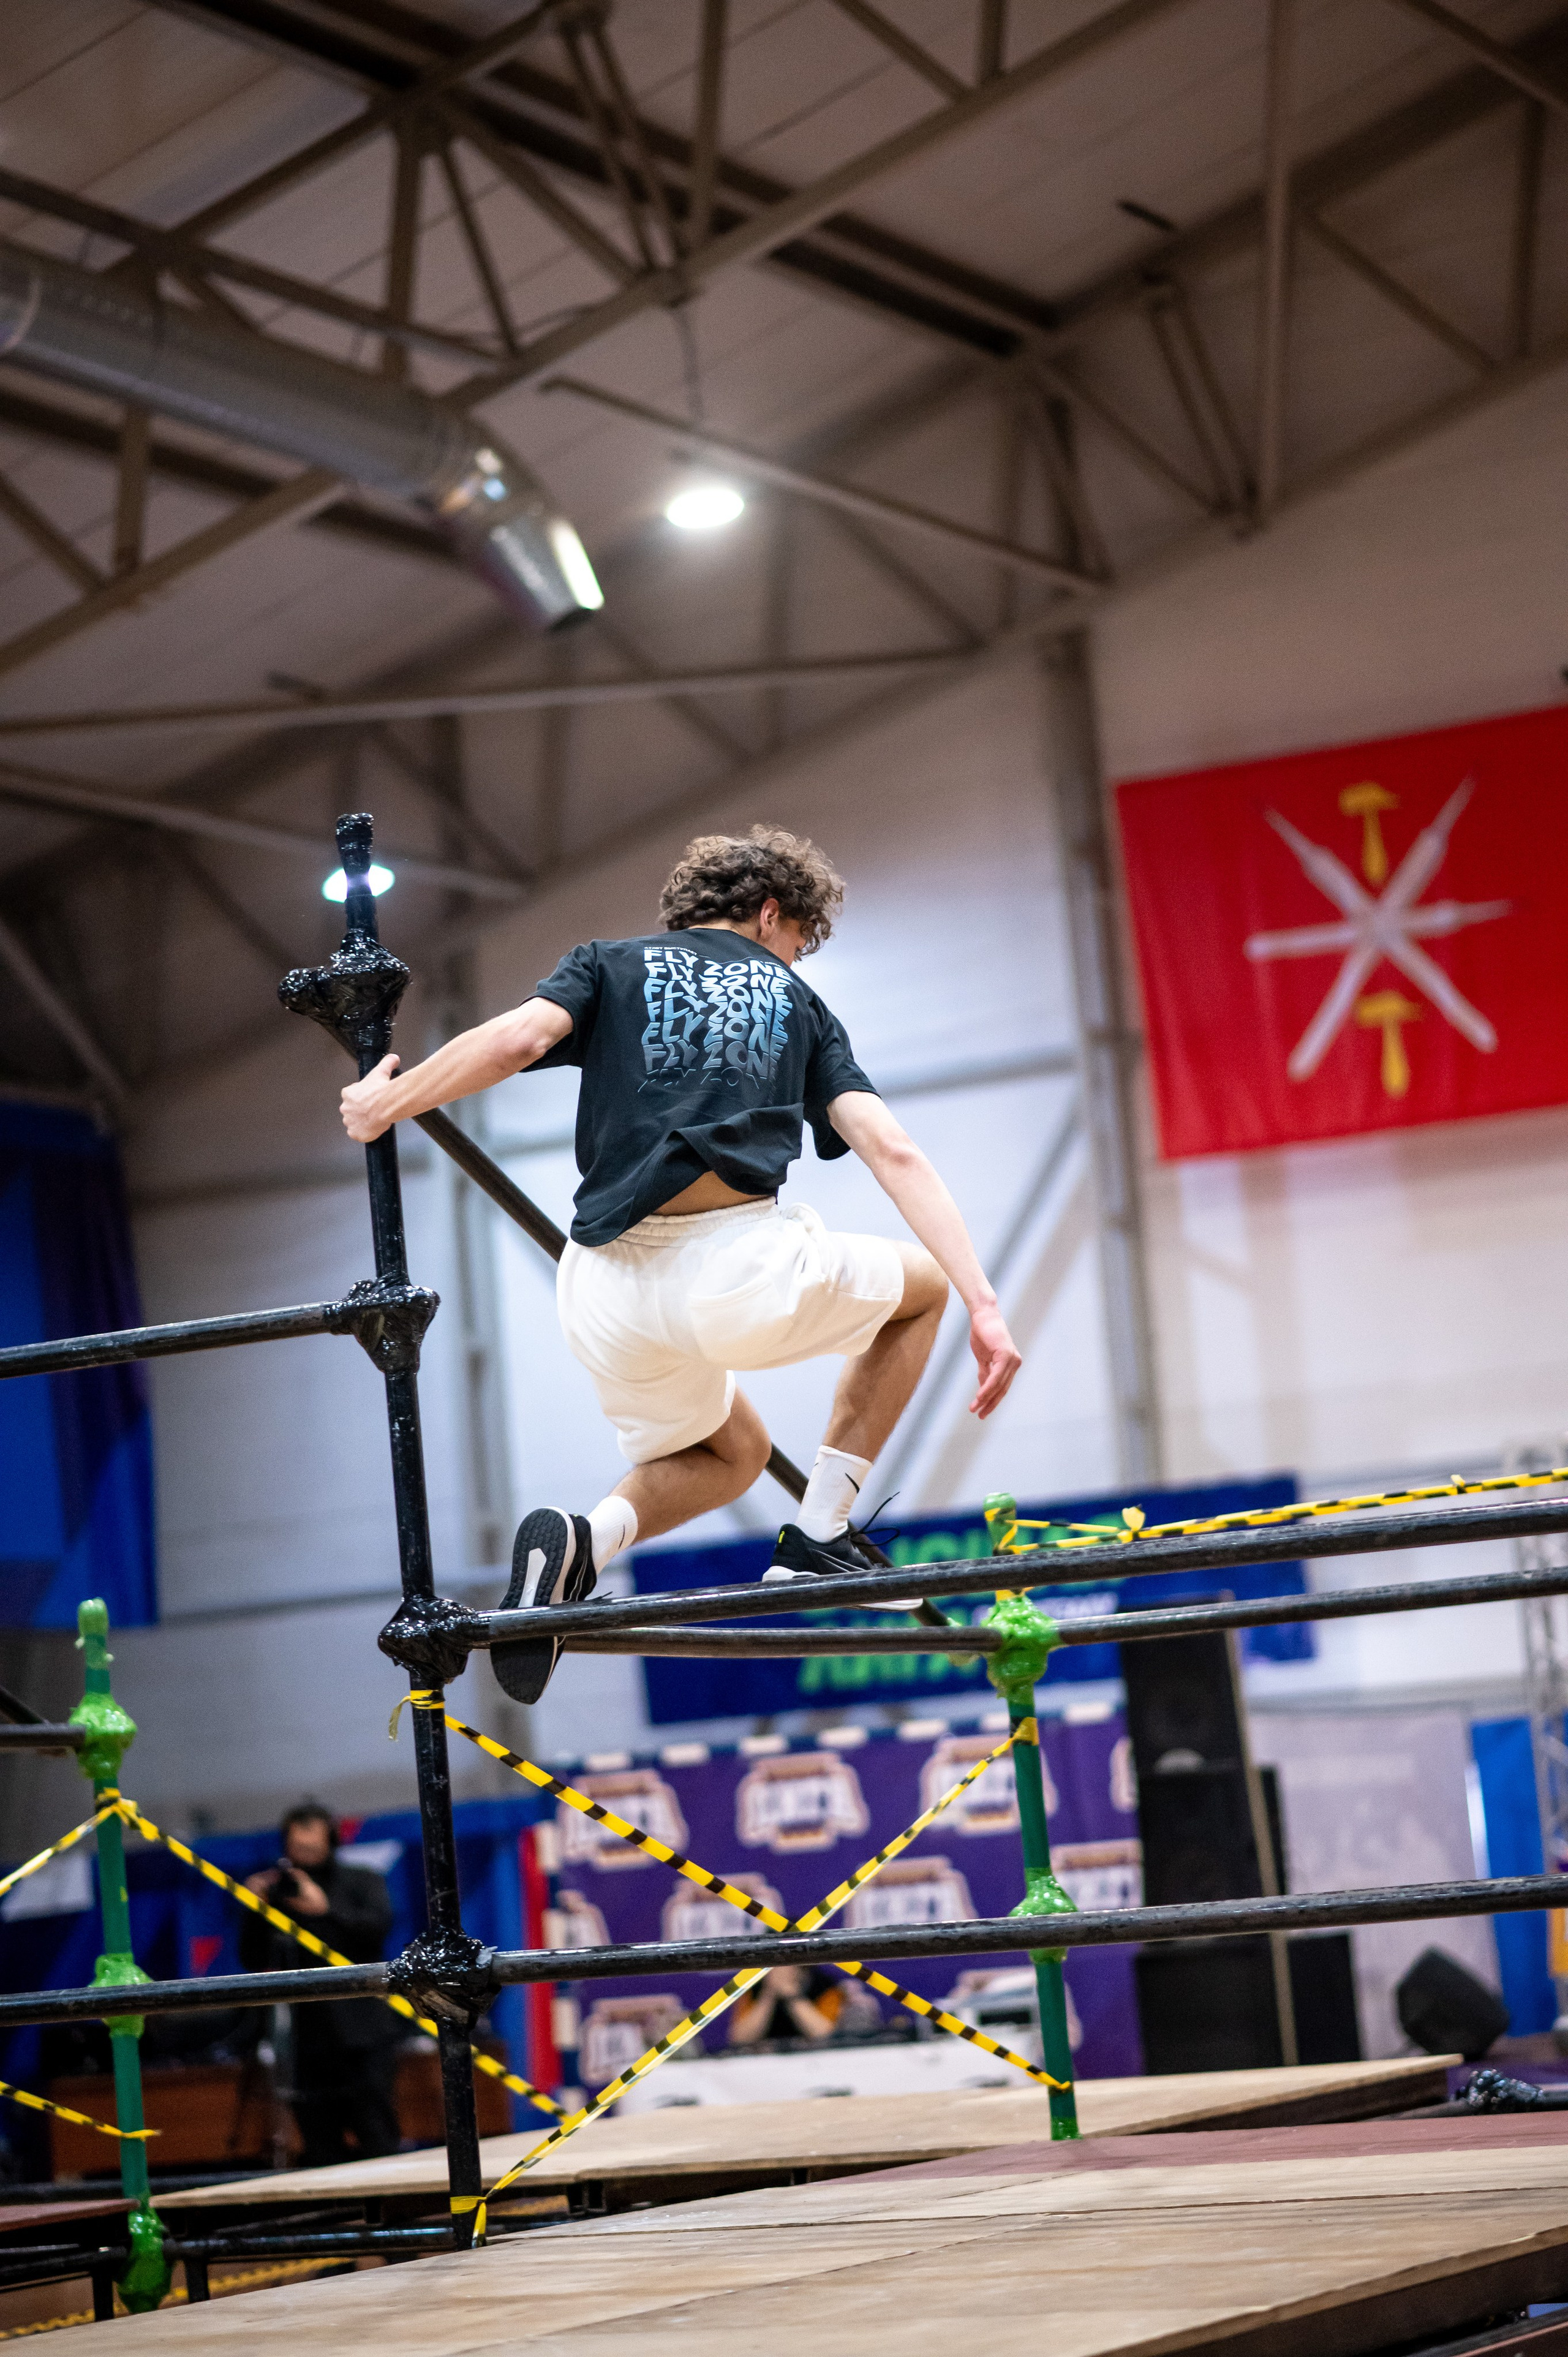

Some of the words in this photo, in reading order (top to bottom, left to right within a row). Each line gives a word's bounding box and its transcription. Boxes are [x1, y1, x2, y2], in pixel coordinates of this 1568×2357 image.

[644, 950, 699, 968] FLY
[704, 960, 793, 982] ZONE
[645, 962, 693, 981] FLY
[699, 975, 791, 994] ZONE
[644, 978, 698, 1001] FLY
[702, 986, 793, 1017] ZONE
[641, 1012, 704, 1044] FLY
[704, 1017, 788, 1060] ZONE
[647, 995, 708, 1022] FLY
[708, 998, 788, 1039] ZONE
[643, 1039, 698, 1071] FLY
[703, 1041, 777, 1077] ZONE
